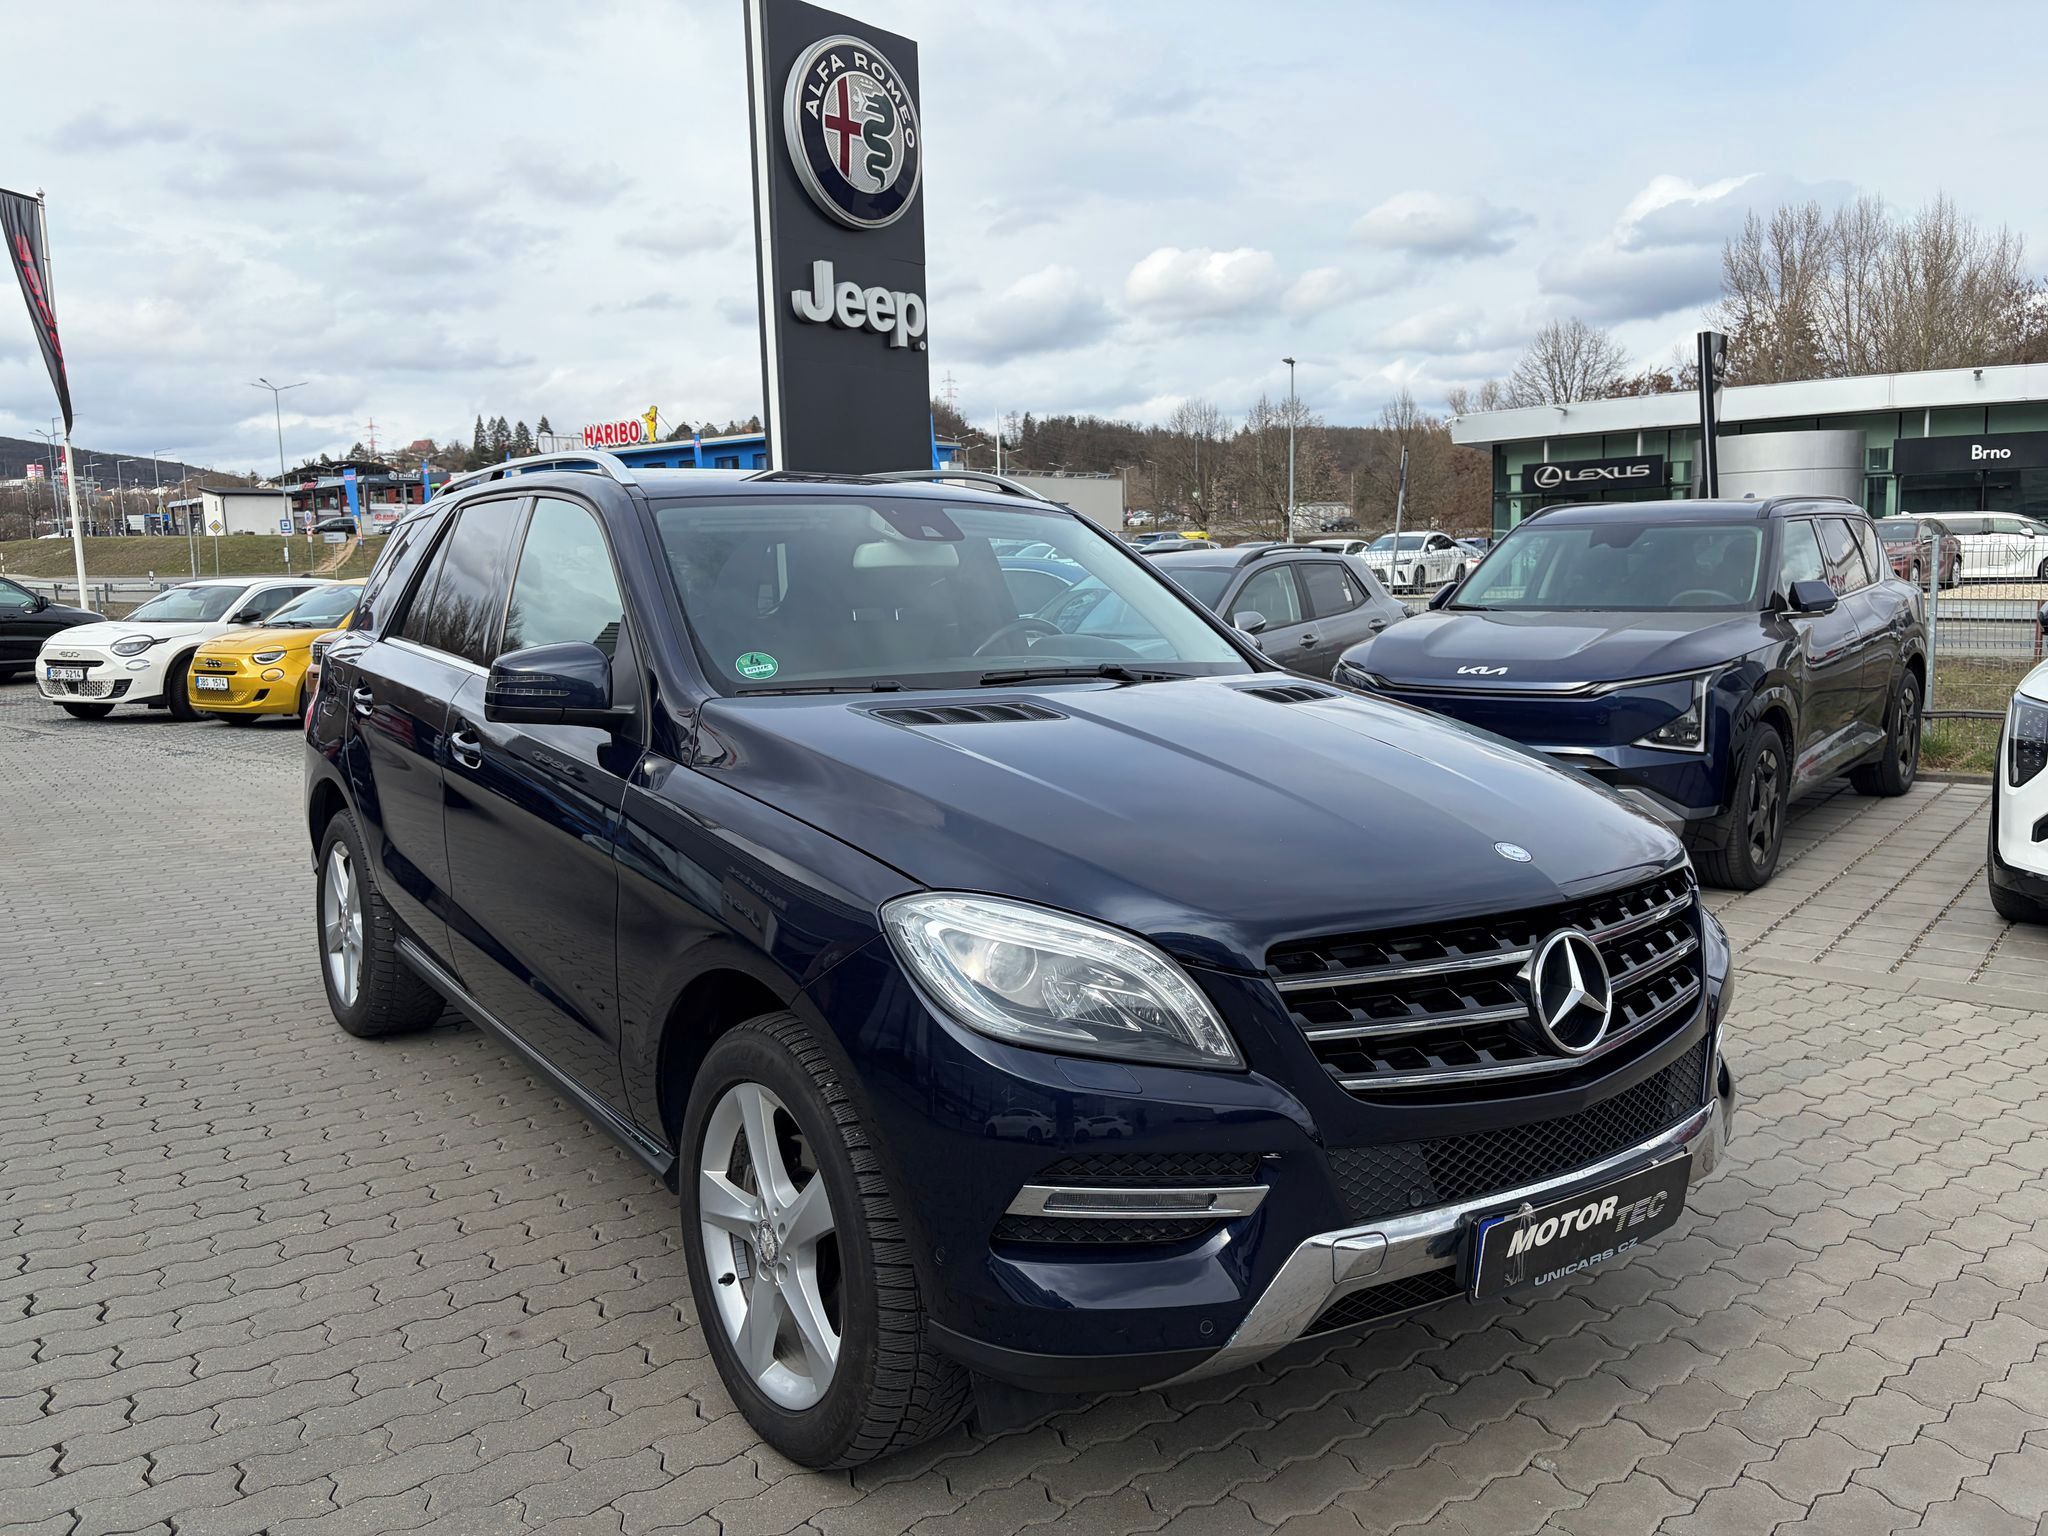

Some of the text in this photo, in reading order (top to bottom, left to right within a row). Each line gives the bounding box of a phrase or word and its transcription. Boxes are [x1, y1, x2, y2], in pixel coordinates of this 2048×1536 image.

[805, 51, 916, 150] ALFA ROMEO
[791, 259, 926, 348] Jeep
[583, 420, 640, 447] HARIBO
[1971, 444, 2012, 461] Brno
[1565, 464, 1650, 482] LEXUS
[65, 669, 81, 678] 5214
[1456, 665, 1509, 676] KIA
[1534, 1248, 1614, 1286] UNICARS
